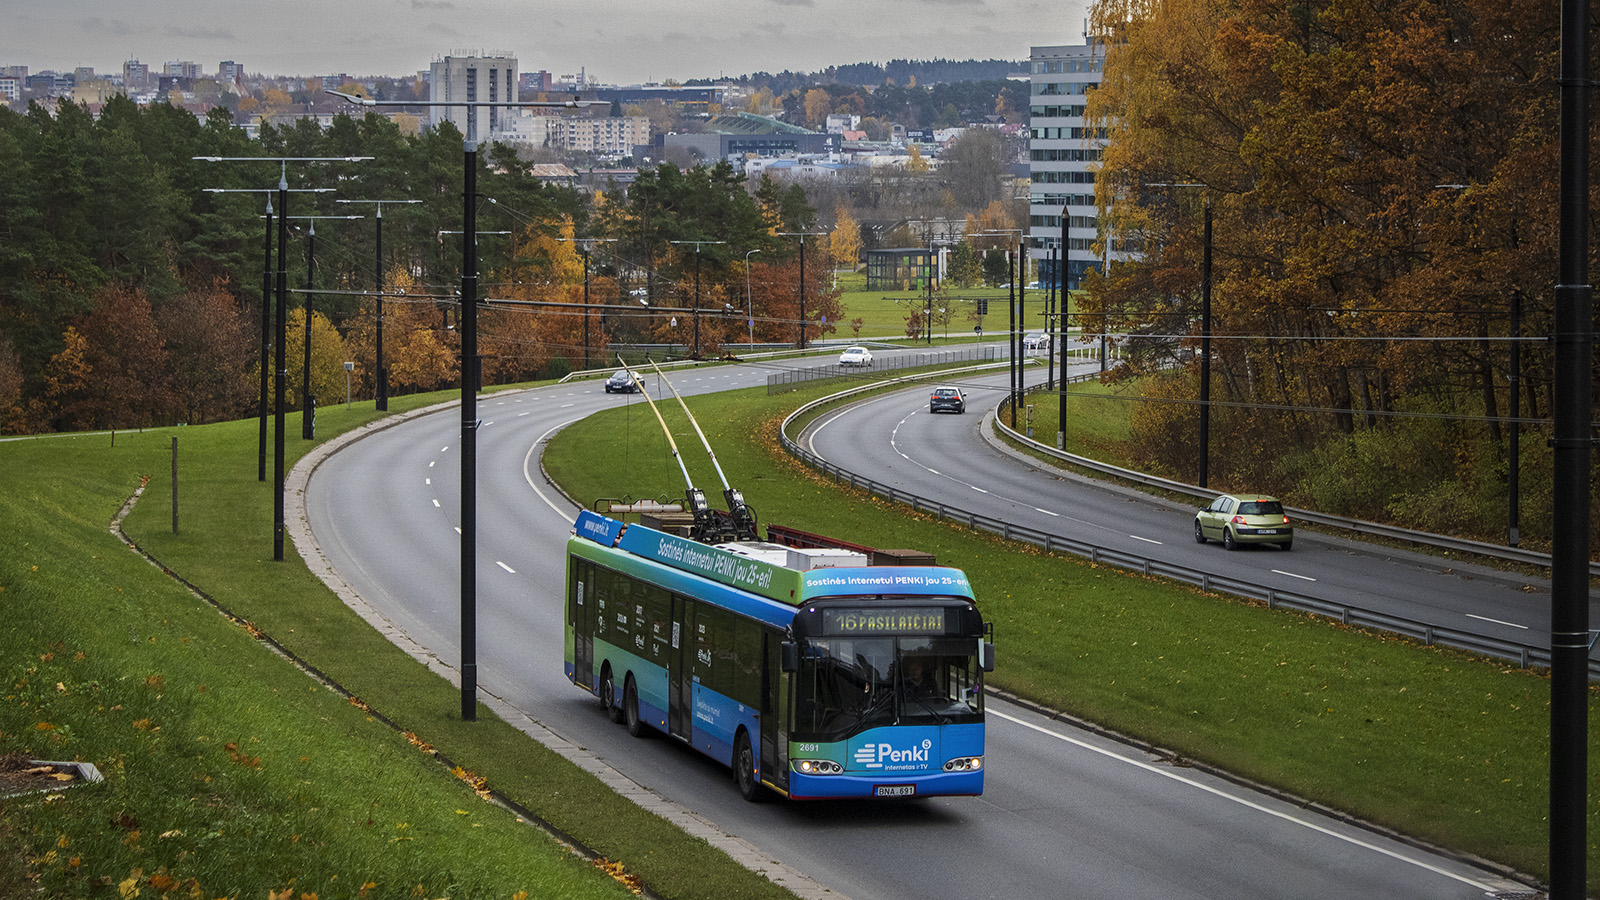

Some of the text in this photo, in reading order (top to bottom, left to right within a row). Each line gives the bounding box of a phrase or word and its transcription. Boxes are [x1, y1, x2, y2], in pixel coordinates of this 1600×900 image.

[682, 543, 717, 572] internetui
[713, 554, 737, 578] PENKI
[732, 559, 748, 585] jau
[746, 563, 773, 590] 25-eri!
[806, 576, 846, 587] Sostinės
[848, 575, 894, 585] internetui
[895, 576, 924, 585] PENKI
[925, 576, 940, 586] jau
[836, 614, 857, 631] 16
[799, 743, 819, 752] 2691
[878, 743, 929, 763] Penki
